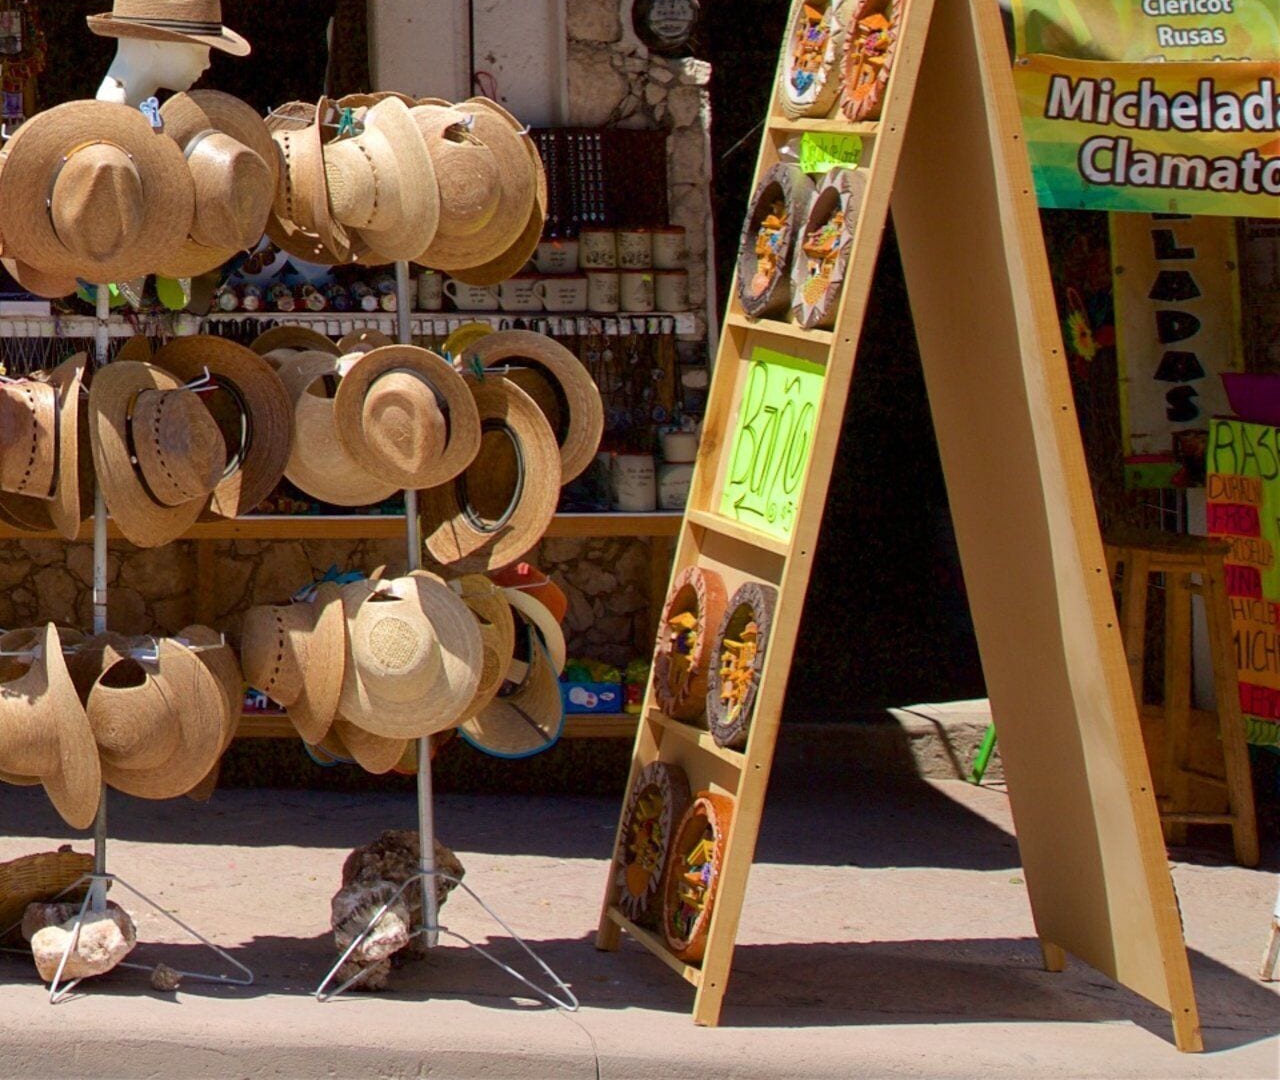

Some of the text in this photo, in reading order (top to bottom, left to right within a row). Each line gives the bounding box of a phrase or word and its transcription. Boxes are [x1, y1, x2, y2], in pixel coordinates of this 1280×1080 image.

[1157, 26, 1226, 46] Rusas
[1046, 76, 1280, 131] Michelad
[1213, 421, 1280, 481] RAS
